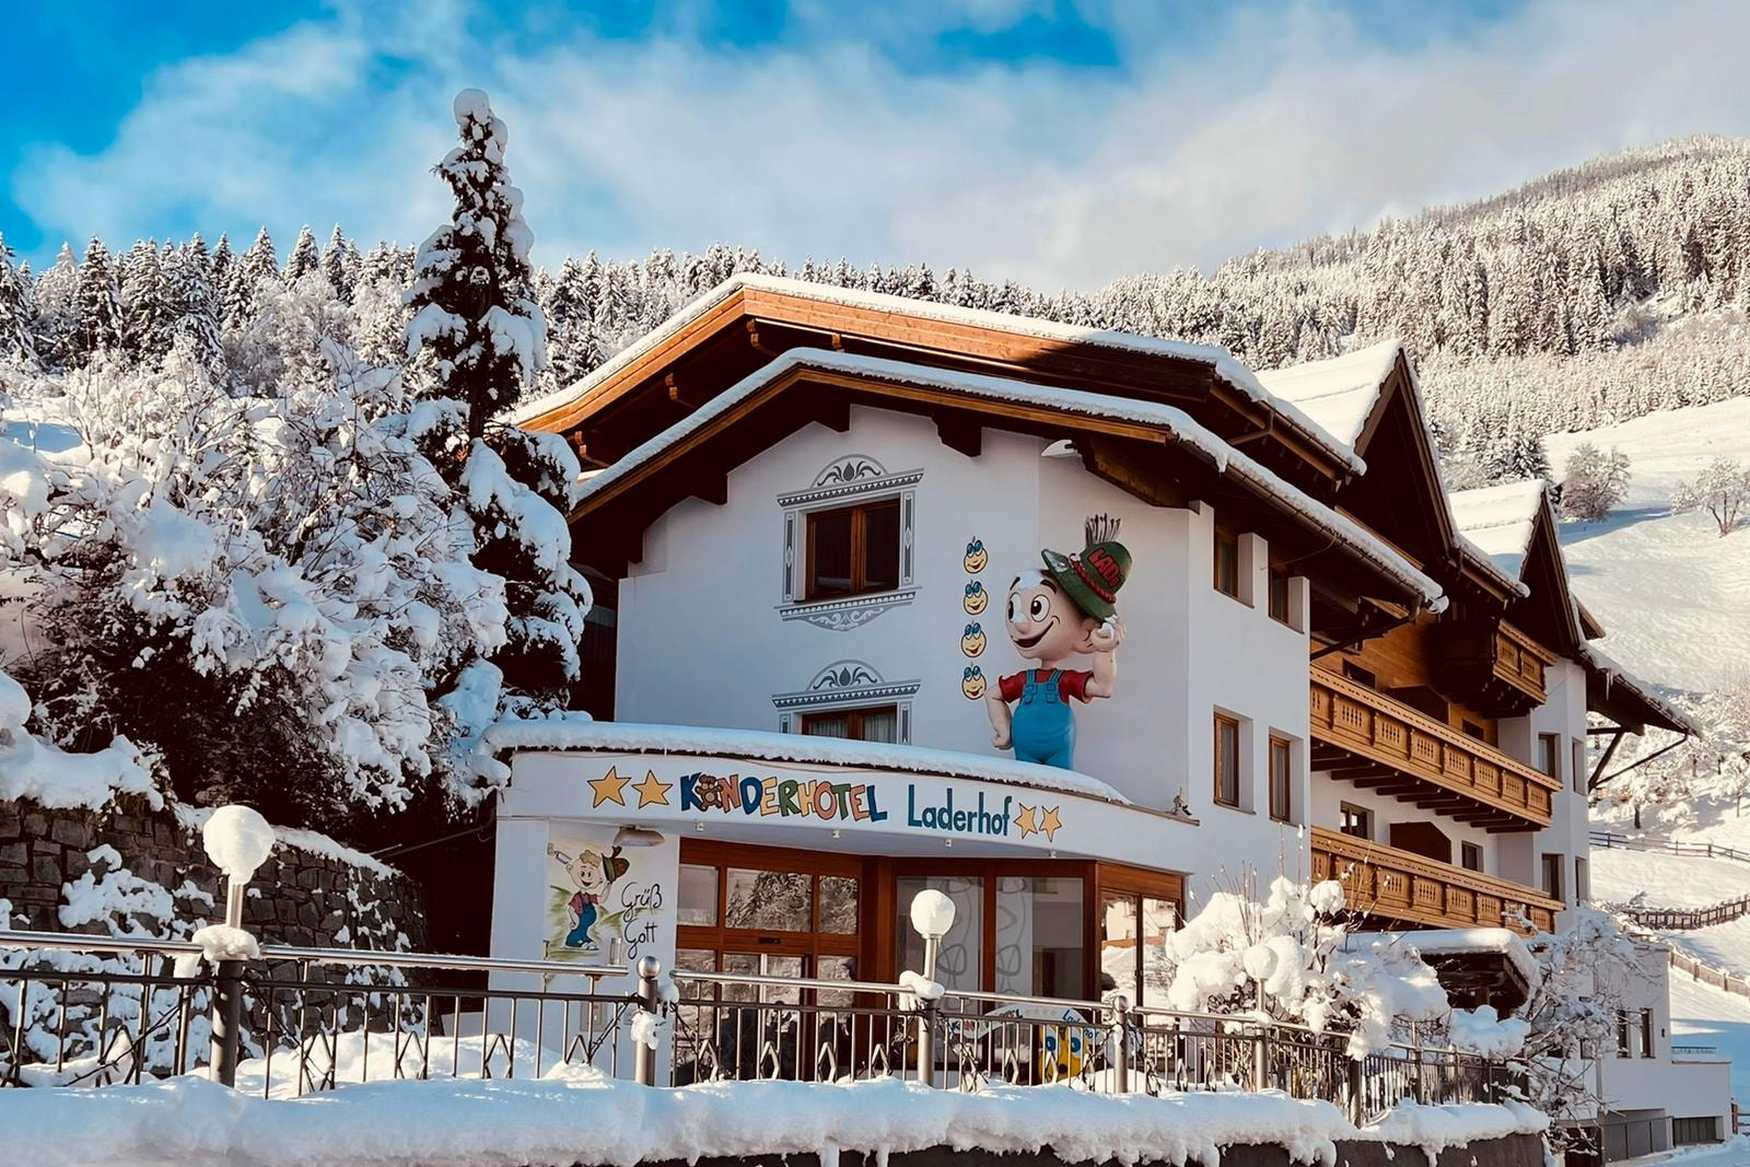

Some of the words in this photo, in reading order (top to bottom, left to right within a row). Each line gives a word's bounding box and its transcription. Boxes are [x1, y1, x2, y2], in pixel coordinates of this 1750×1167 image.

[680, 772, 888, 822] KNDERHOTEL
[908, 784, 1012, 836] Laderhof
[621, 881, 662, 923] Grüß
[624, 918, 658, 960] Gott
